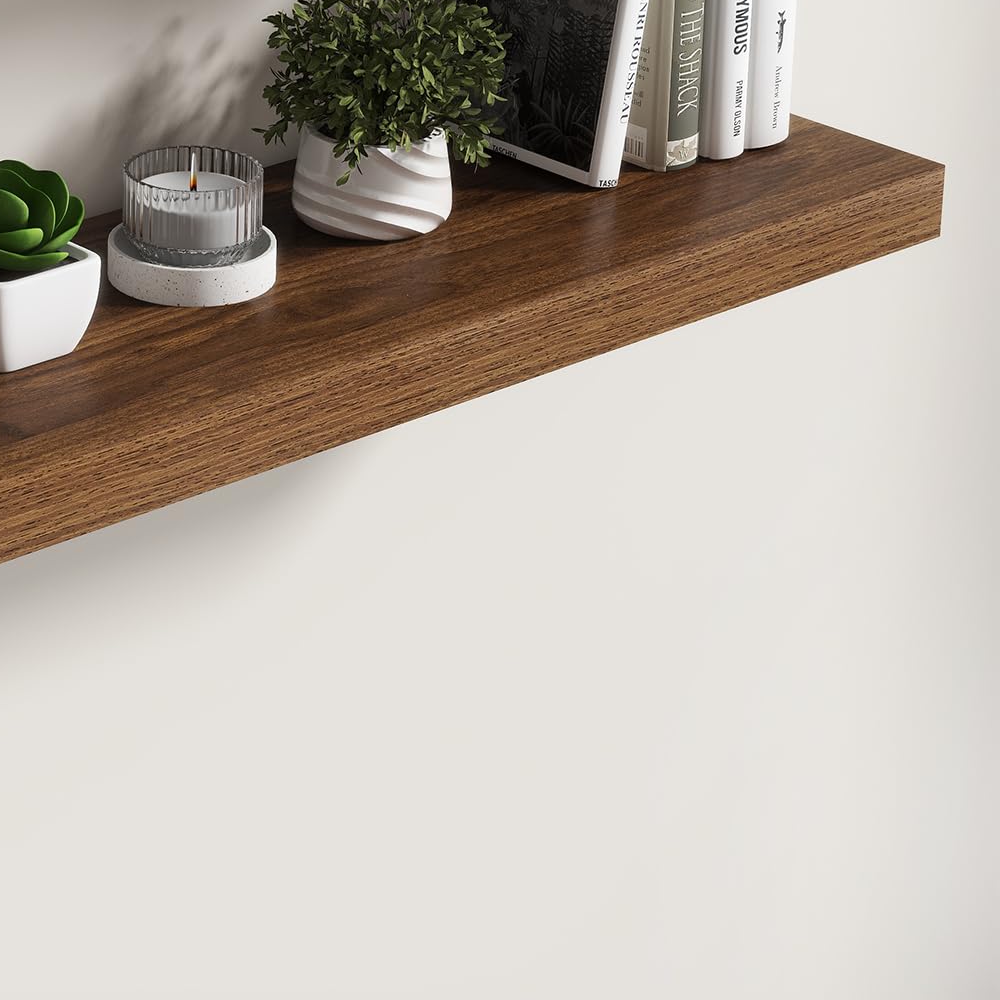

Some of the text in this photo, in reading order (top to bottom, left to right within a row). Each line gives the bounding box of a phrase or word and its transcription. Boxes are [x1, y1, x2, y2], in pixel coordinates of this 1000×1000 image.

[620, 36, 642, 124] ROUSSEAU
[677, 2, 705, 117] THE SHACK
[733, 80, 744, 137] PARMY OLSON
[599, 179, 617, 187] TASC
